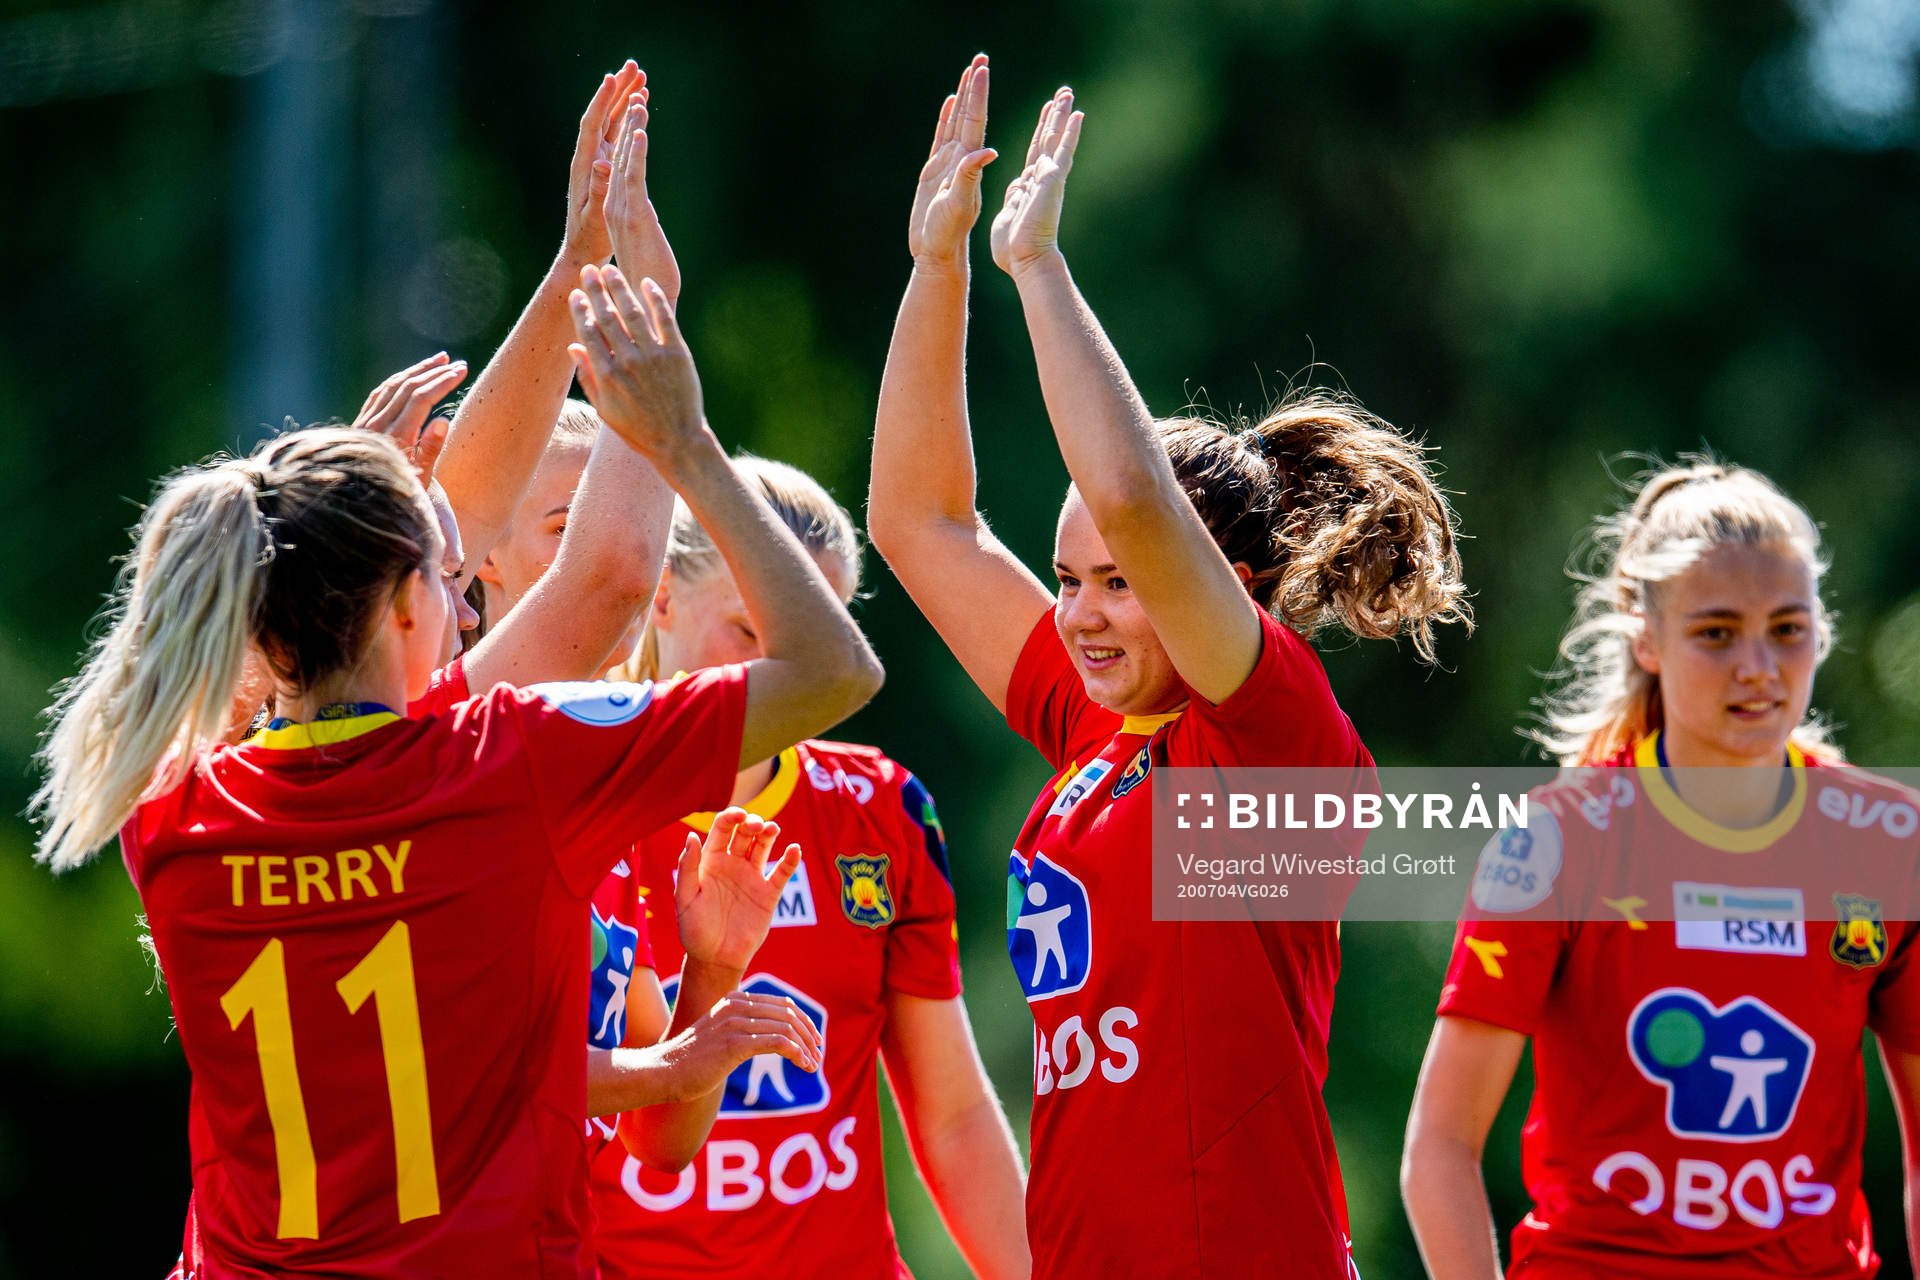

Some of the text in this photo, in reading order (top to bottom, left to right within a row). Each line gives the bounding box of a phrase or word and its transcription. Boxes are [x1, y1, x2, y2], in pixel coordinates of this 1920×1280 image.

[1817, 786, 1919, 838] evo
[222, 840, 412, 906] TERRY
[1724, 918, 1797, 948] RSM
[220, 919, 441, 1240] 11
[620, 1116, 859, 1212] OBOS
[1593, 1151, 1837, 1230] OBOS
